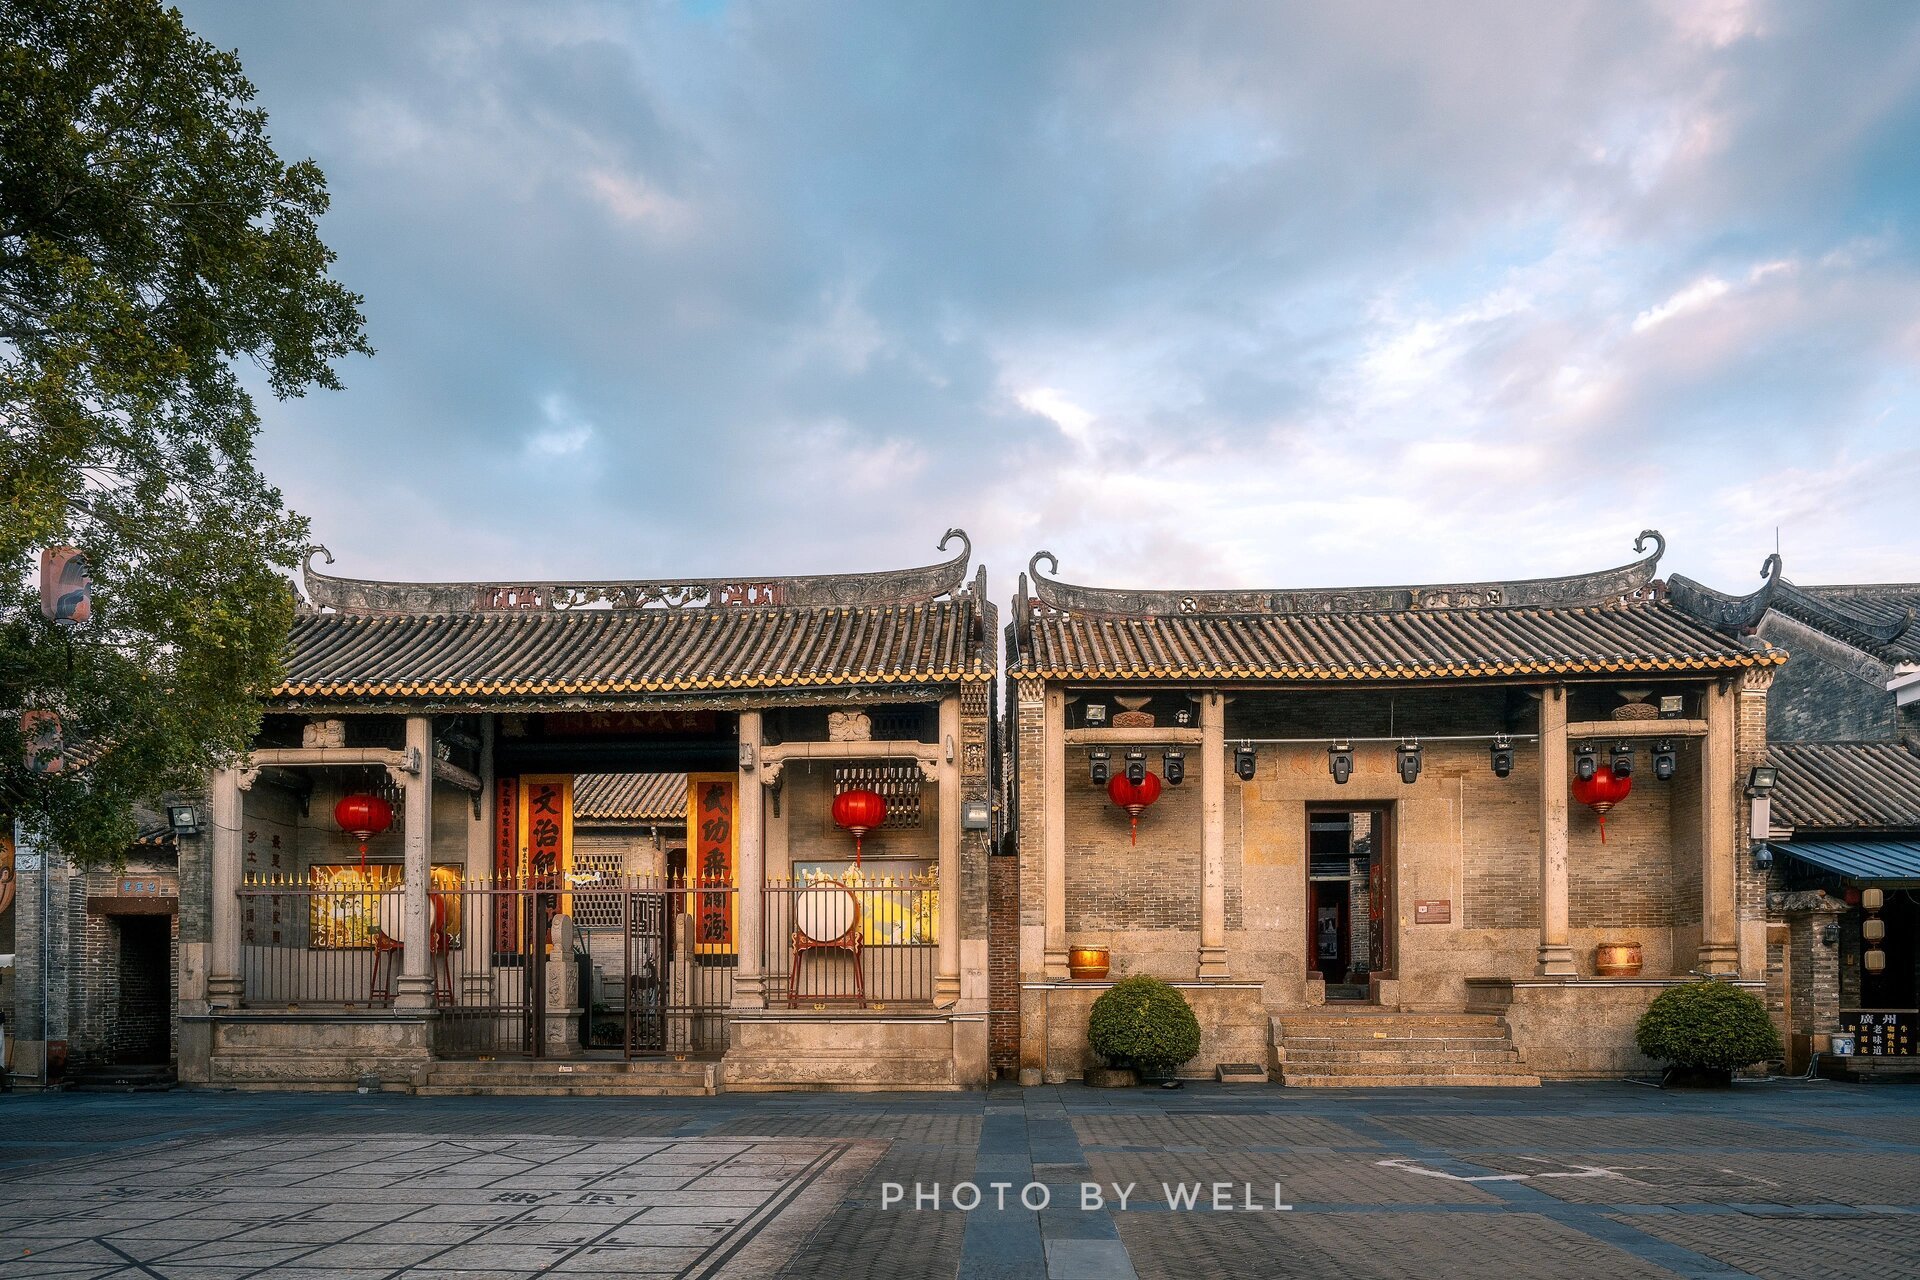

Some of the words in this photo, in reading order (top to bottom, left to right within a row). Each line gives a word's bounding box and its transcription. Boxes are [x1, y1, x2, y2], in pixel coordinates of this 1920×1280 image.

[1859, 1013, 1897, 1025] 廣州
[1860, 1024, 1869, 1054] 豆腐花
[1872, 1024, 1883, 1055] 老味道
[1900, 1024, 1908, 1055] 牛筋丸
